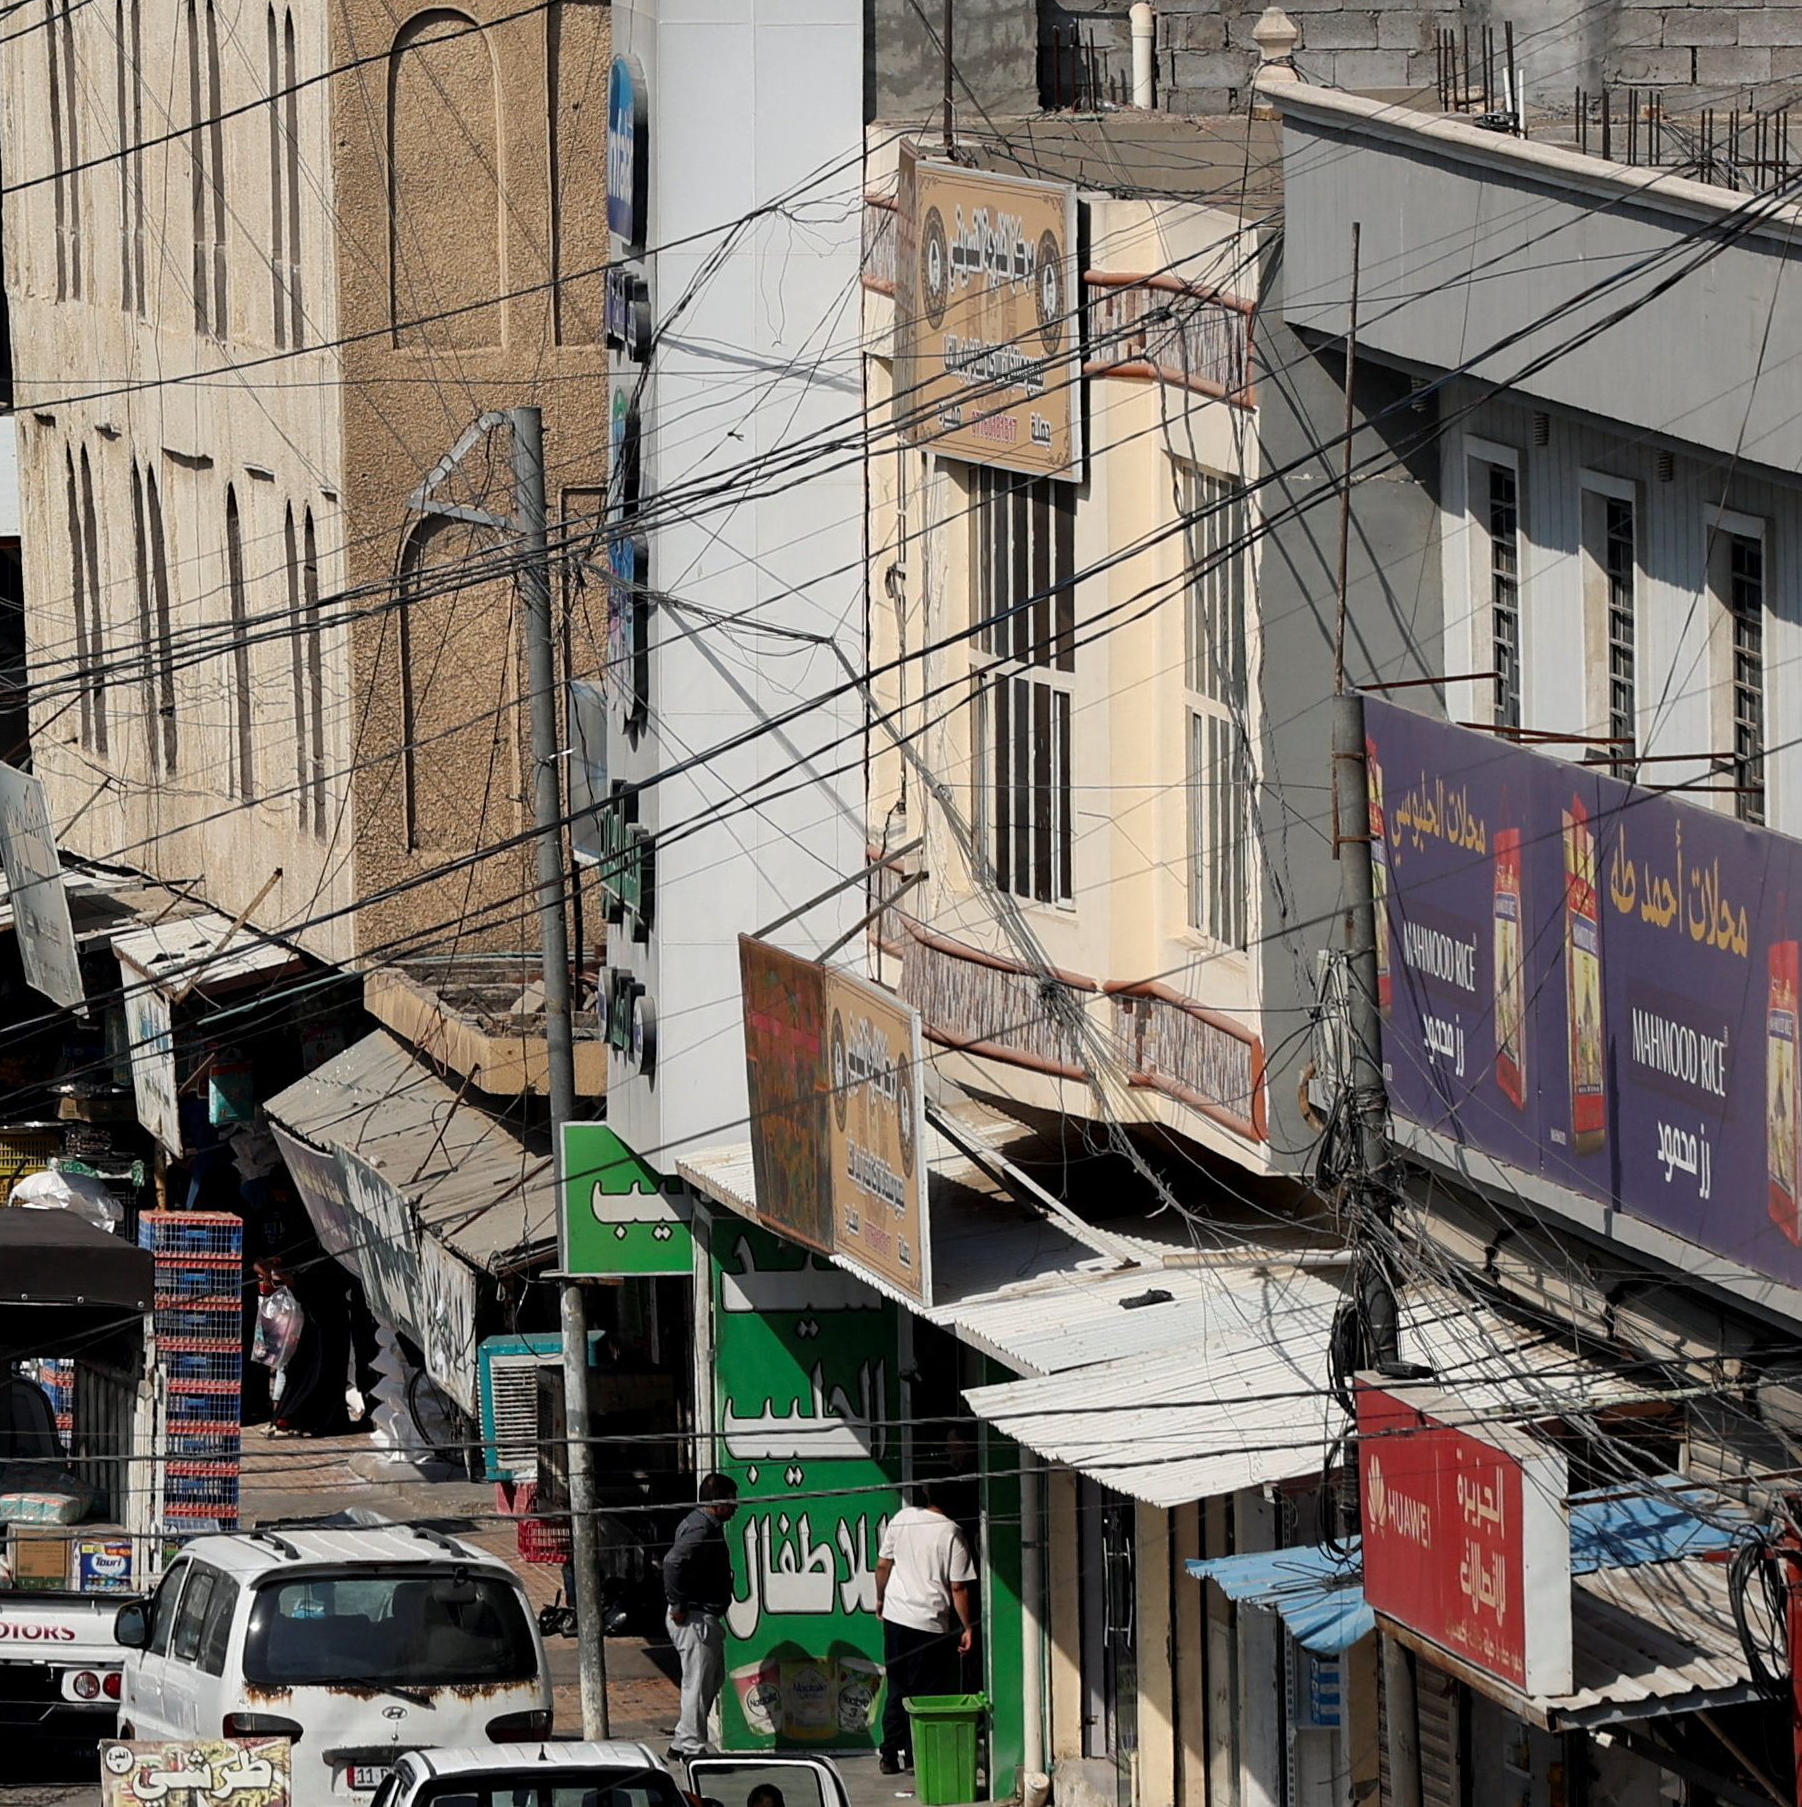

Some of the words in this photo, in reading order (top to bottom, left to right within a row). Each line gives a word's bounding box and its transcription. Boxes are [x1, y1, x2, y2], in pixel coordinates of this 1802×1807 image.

[1446, 782, 1487, 857] محلات
[1609, 821, 1637, 915] طه
[1640, 817, 1685, 936] أحمد
[1688, 854, 1749, 959] محلات
[1402, 920, 1455, 985] MAHMOOD
[1455, 940, 1477, 993] RICE
[1422, 1012, 1455, 1065] محمود
[1454, 1013, 1466, 1078] رز
[1631, 1006, 1698, 1086] MAHMOOD
[1700, 1033, 1727, 1098] RICE
[1656, 1120, 1698, 1184] محمود
[1698, 1121, 1711, 1201] رز
[722, 1357, 887, 1488] الحليب
[1387, 1487, 1432, 1550] HUAWEI
[1454, 1446, 1508, 1541] الجزيرة
[357, 1767, 375, 1785] 11
